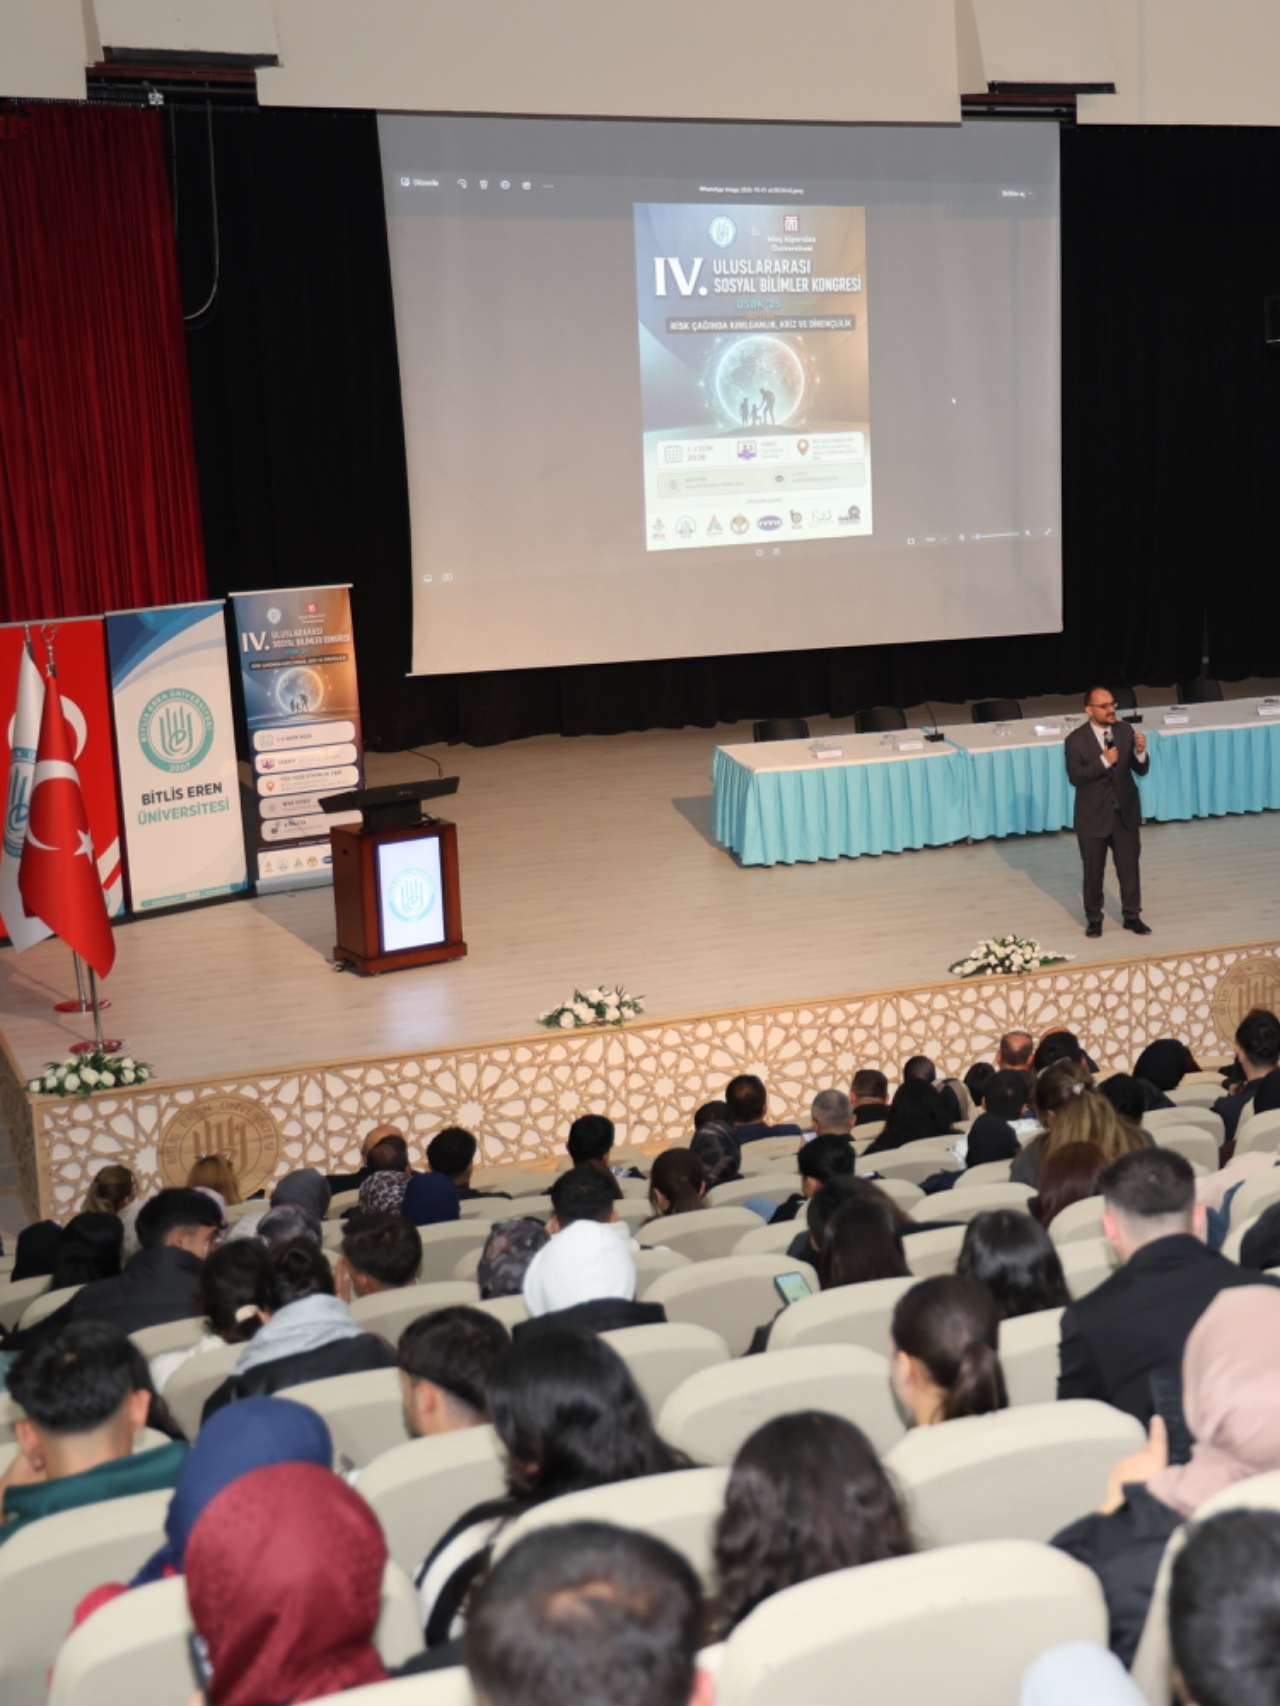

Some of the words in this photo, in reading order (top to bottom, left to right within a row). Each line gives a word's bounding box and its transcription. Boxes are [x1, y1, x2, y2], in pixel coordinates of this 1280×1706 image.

[653, 257, 708, 296] IV.
[712, 259, 811, 275] ULUSLARARASI
[714, 277, 757, 293] SOSYAL
[759, 274, 808, 293] BİLİMLER
[811, 274, 862, 292] KONGRESİ
[241, 630, 271, 653] IV.
[169, 762, 191, 772] 2007
[141, 786, 184, 807] BİTLİS
[187, 782, 223, 798] EREN
[137, 797, 230, 826] ÜNİVERSİTESİ
